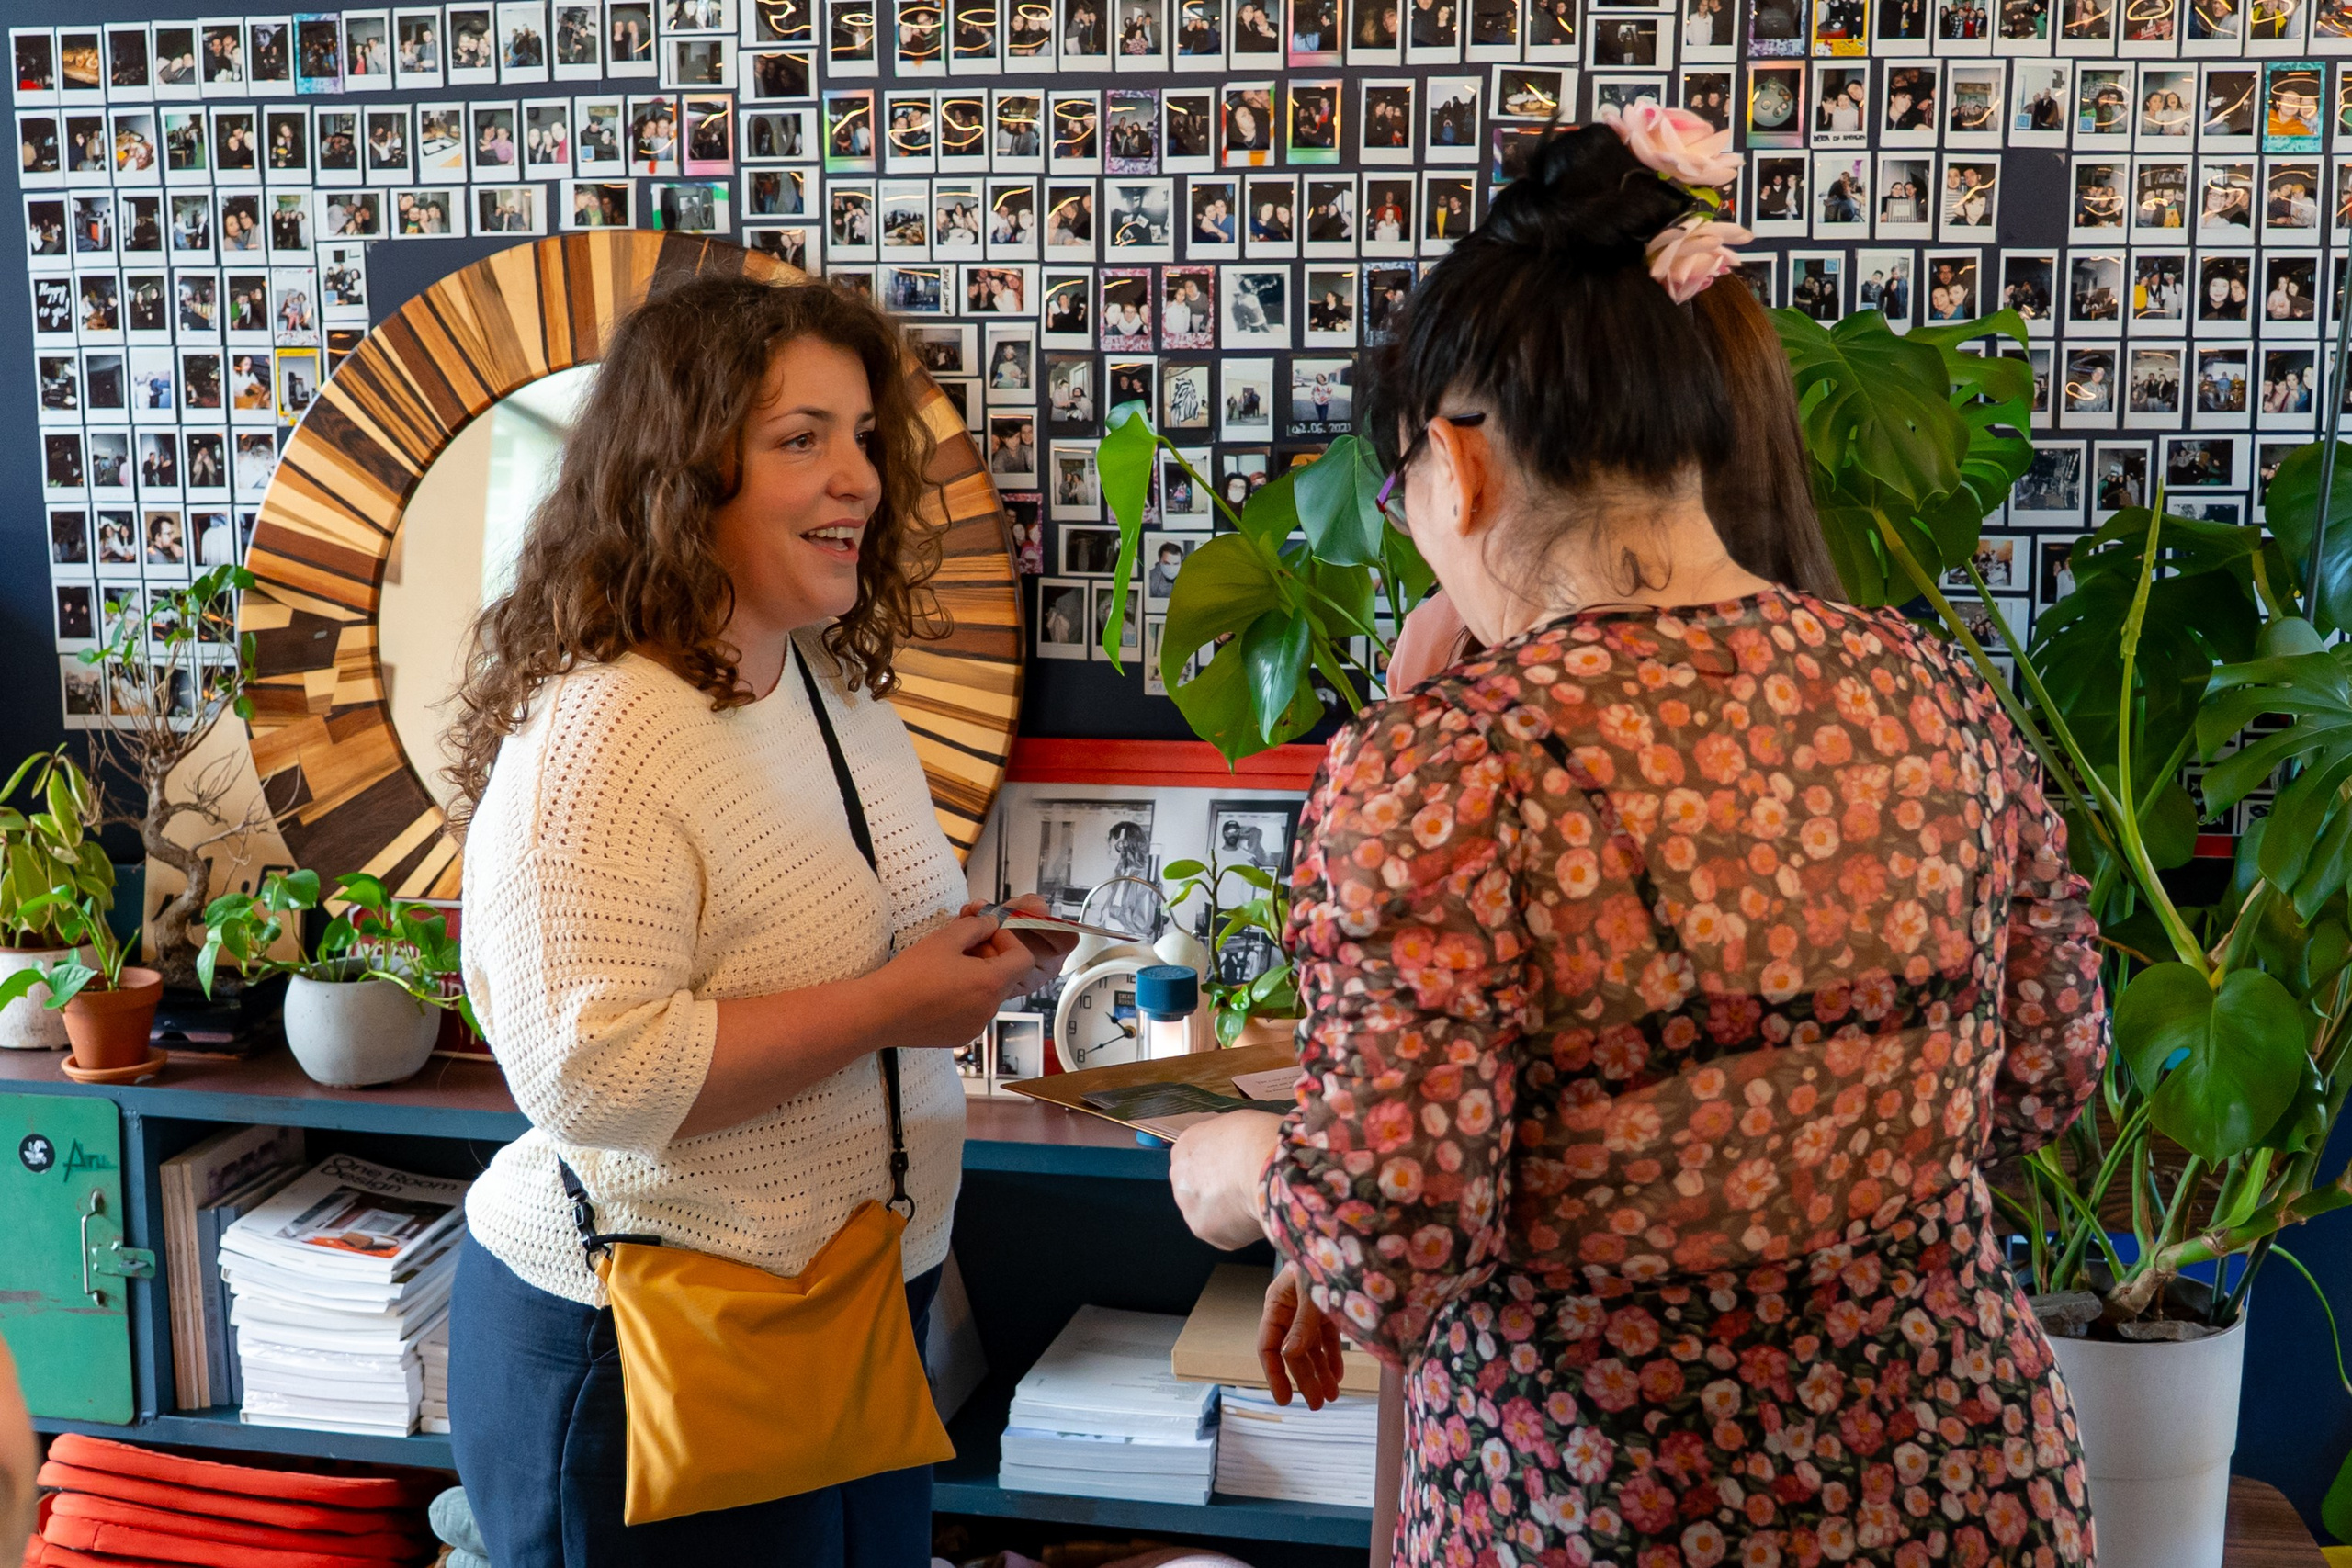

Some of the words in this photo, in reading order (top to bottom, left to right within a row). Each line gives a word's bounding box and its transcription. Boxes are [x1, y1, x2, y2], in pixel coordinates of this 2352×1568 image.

[1099, 976, 1108, 988] 11
[1079, 995, 1091, 1009] 10
[1068, 1020, 1077, 1034] 9
[1077, 1048, 1086, 1063] 8
[321, 1164, 401, 1192] Design
[333, 1157, 382, 1177] One
[386, 1171, 458, 1191] Room
